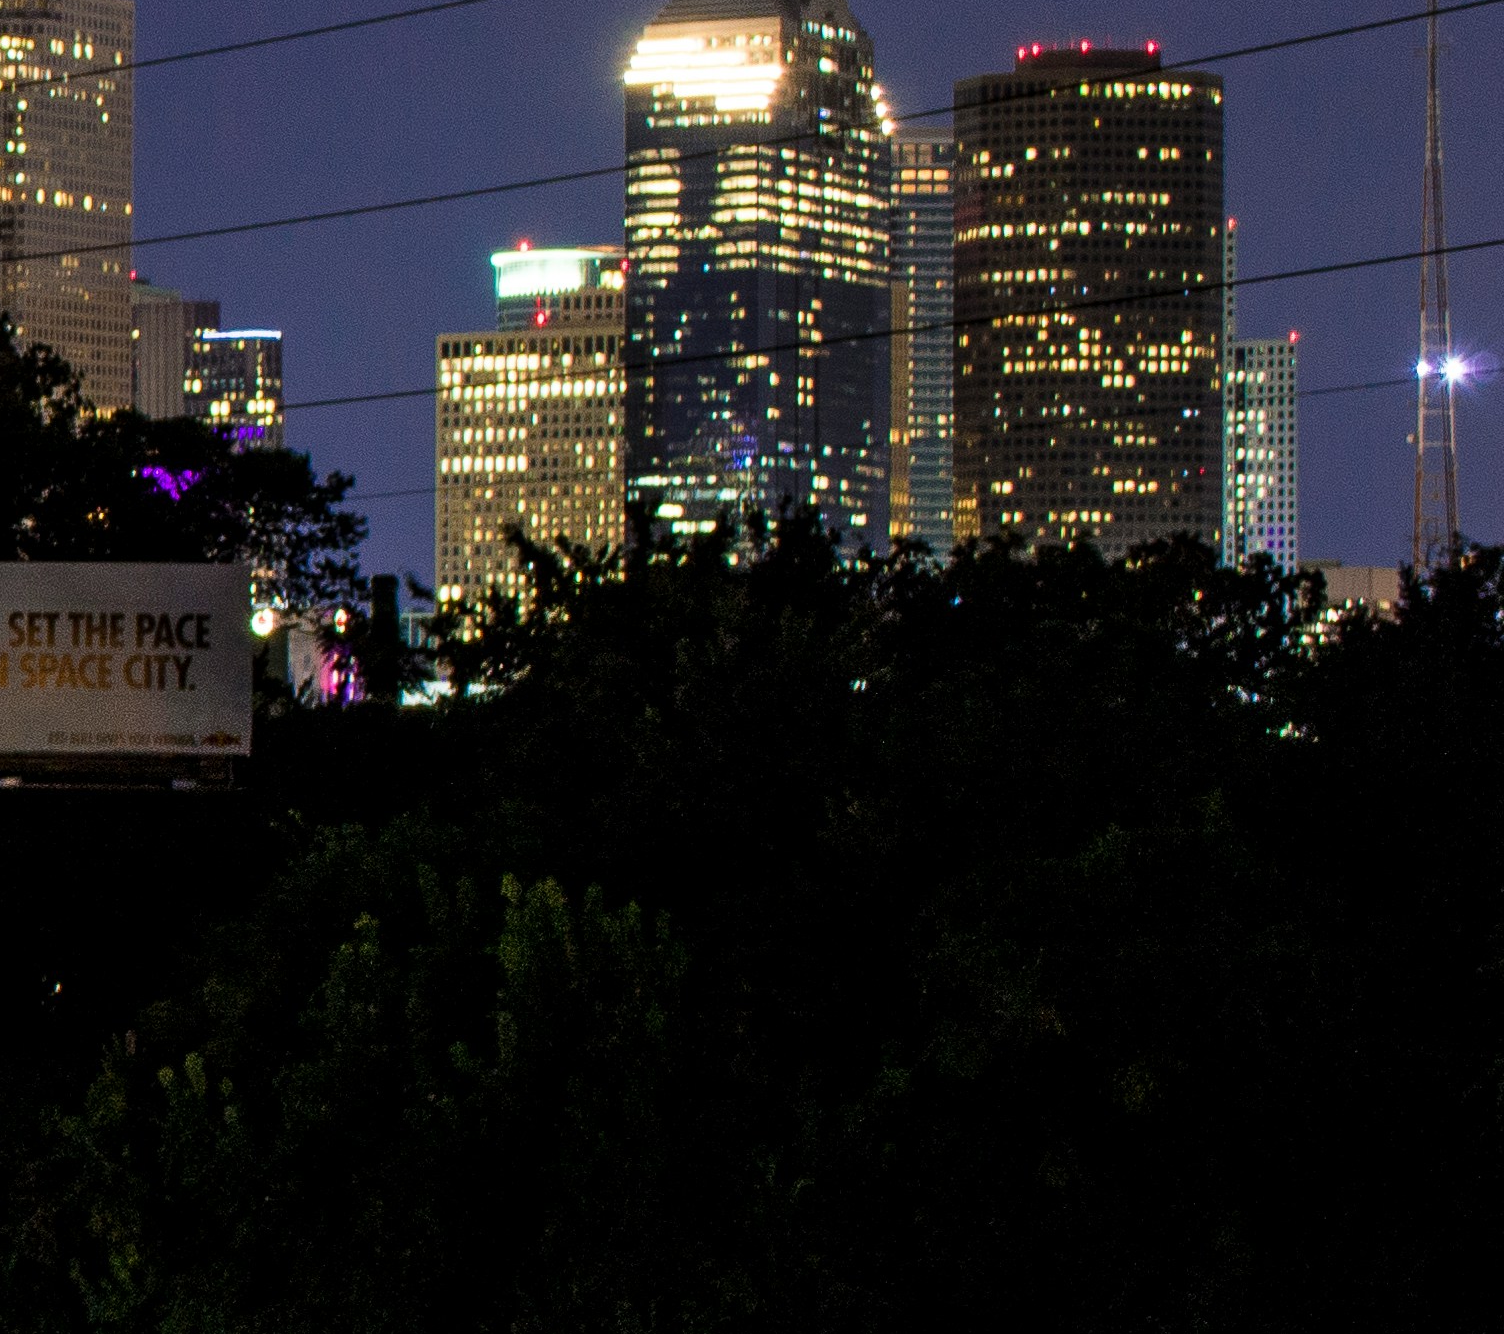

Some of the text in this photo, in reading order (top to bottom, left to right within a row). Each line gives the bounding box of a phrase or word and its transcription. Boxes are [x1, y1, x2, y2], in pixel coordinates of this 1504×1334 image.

[8, 611, 61, 649] SET
[66, 612, 125, 648] THE
[133, 613, 212, 650] PACE
[19, 653, 113, 690] SPACE
[122, 654, 196, 691] CITY.
